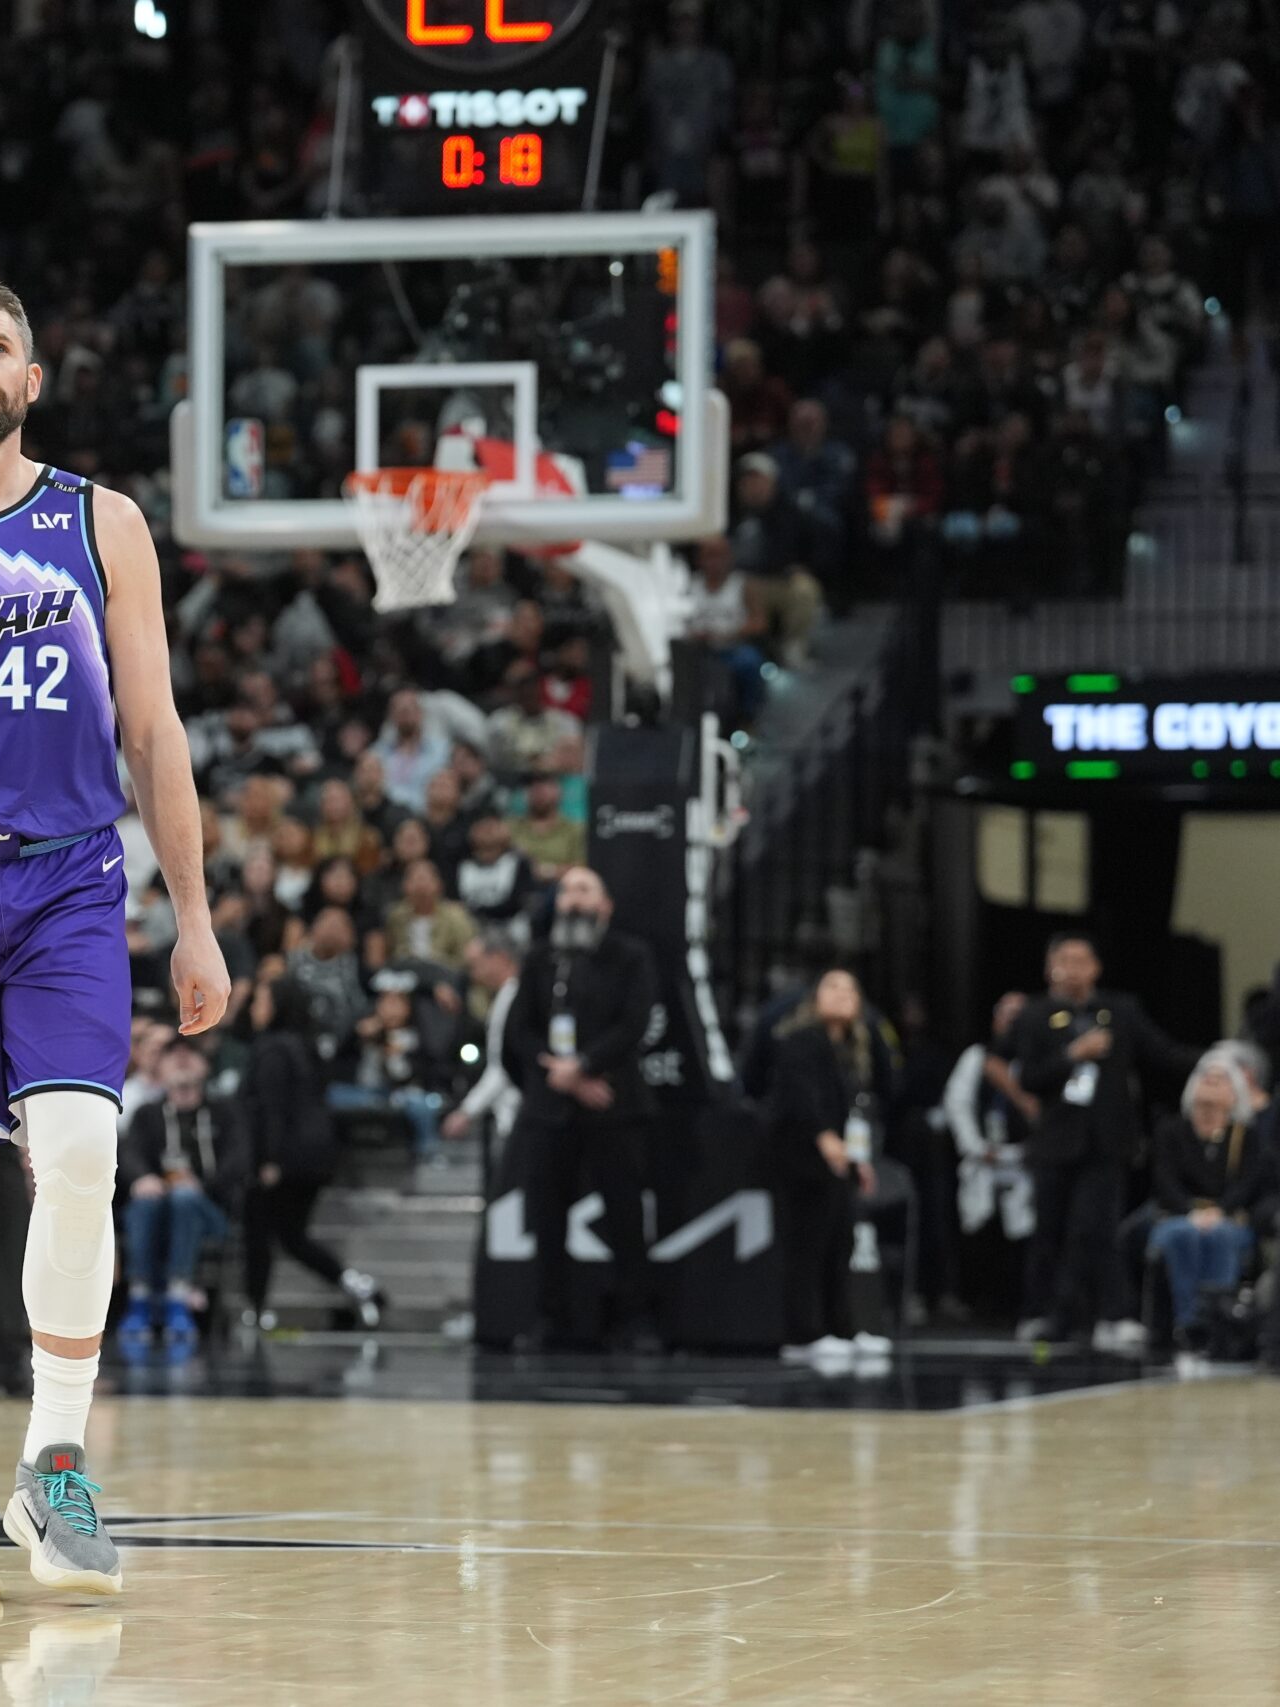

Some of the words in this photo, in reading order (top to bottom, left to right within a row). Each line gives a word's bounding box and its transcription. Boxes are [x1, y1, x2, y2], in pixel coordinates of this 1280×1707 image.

[429, 88, 587, 127] TISSOT
[442, 134, 541, 188] 0:18
[54, 481, 78, 494] FRANK
[31, 513, 73, 530] LVT
[1043, 703, 1148, 750] THE
